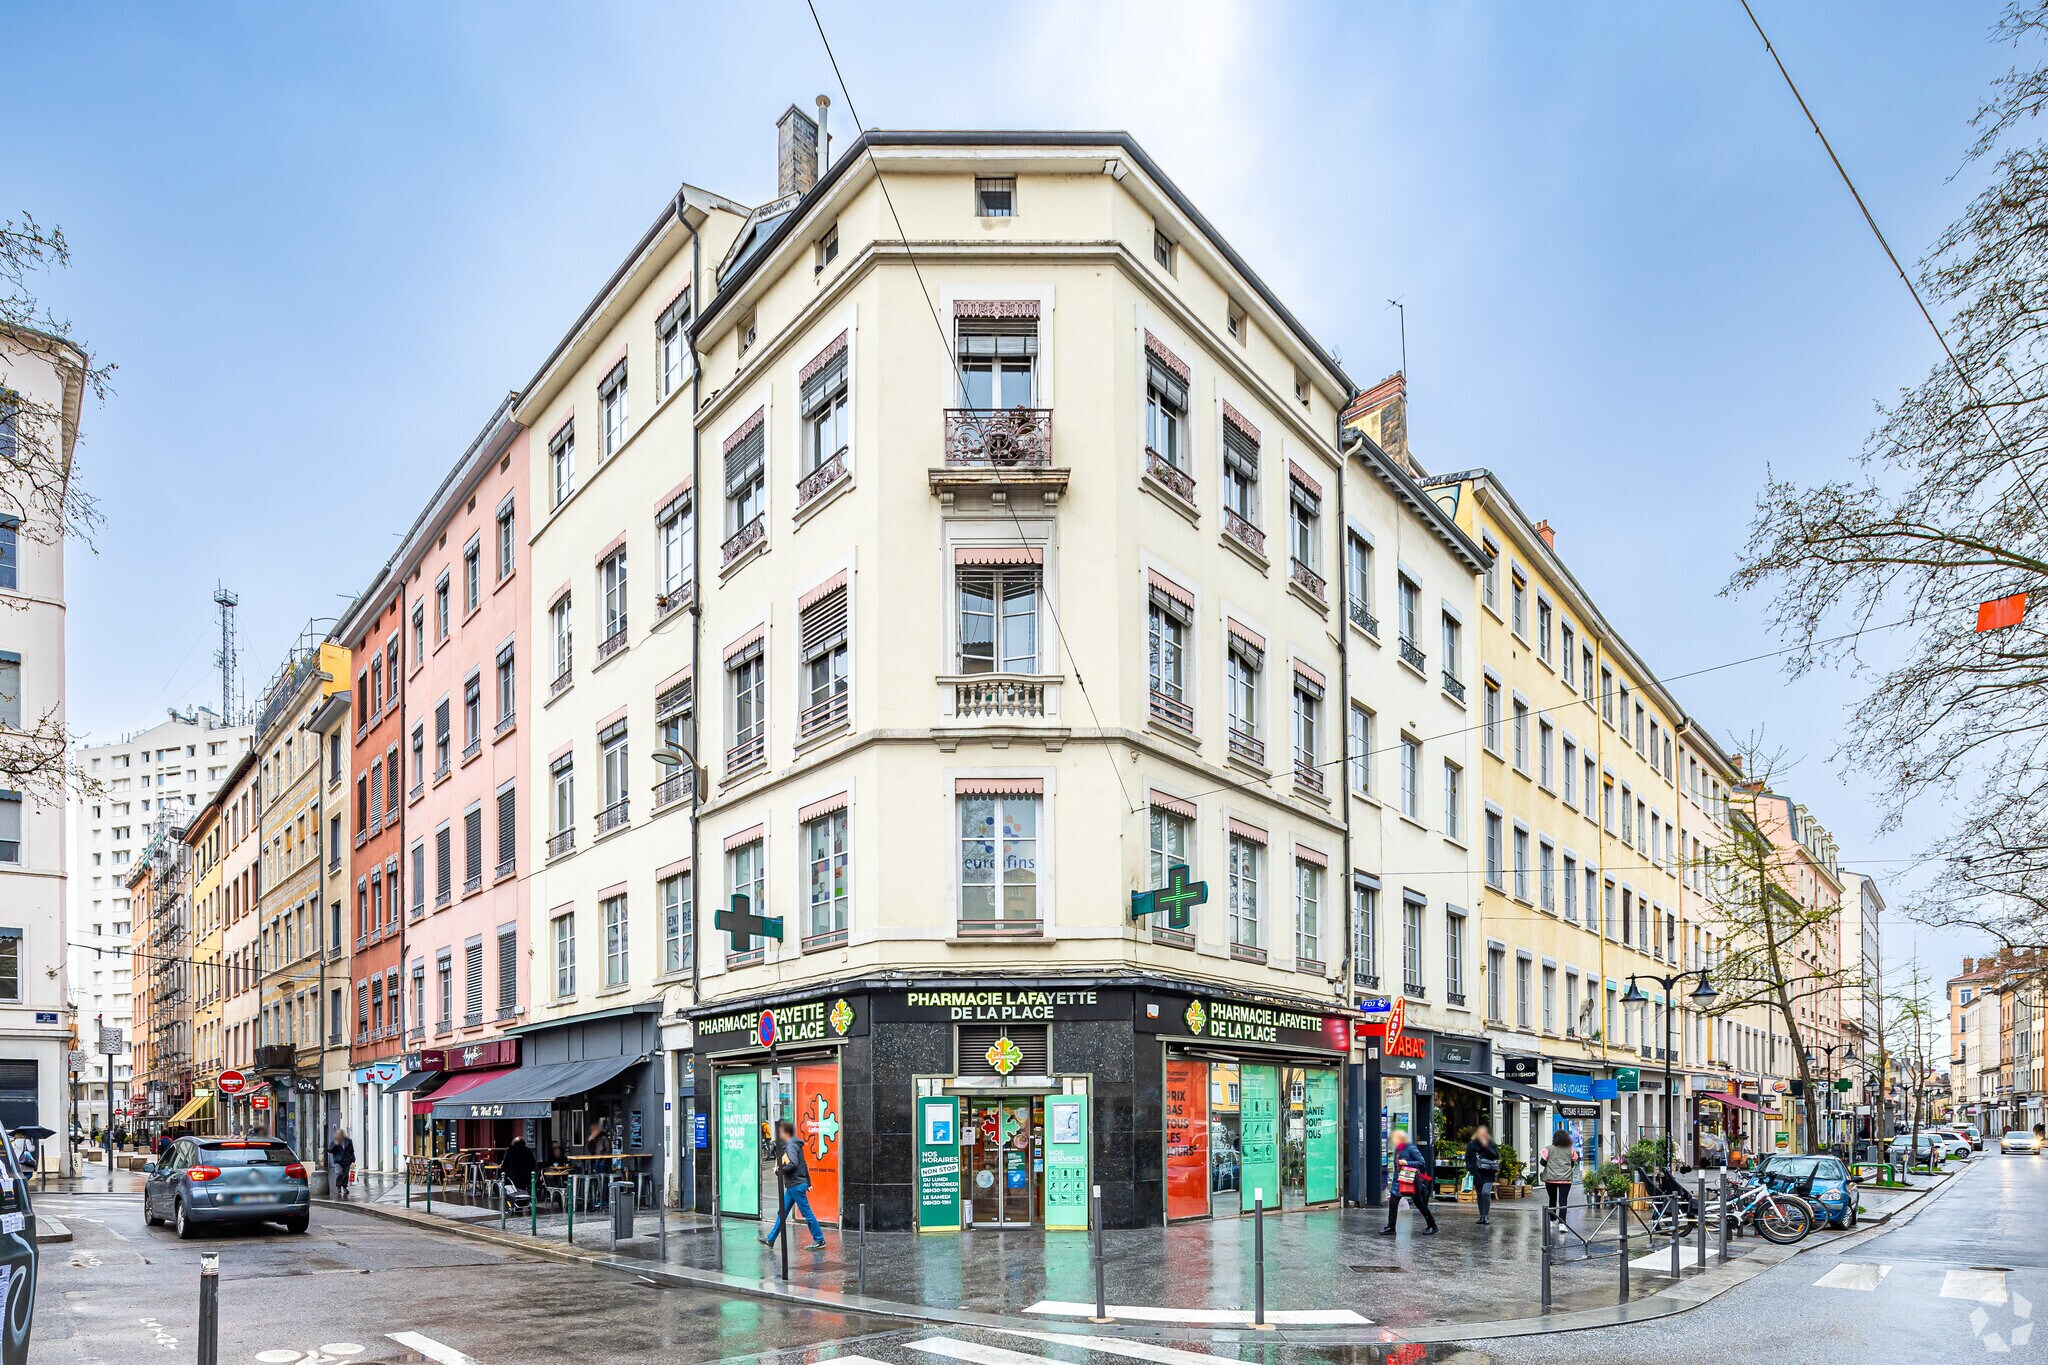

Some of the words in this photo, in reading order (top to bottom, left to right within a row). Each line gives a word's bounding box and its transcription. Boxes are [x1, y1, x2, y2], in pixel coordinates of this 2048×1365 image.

[907, 992, 1003, 1006] PHARMACIE
[1006, 992, 1097, 1006] LAFAYETTE
[950, 1006, 973, 1020] DE
[976, 1006, 998, 1020] LA
[1002, 1006, 1054, 1020] PLACE
[1210, 1002, 1272, 1026] PHARMACIE
[1273, 1012, 1322, 1032] LAFAYETTE
[699, 1012, 758, 1036] PHARMACIE
[760, 1002, 825, 1024] FAYETTE
[784, 1020, 825, 1040] PLACE
[1210, 1020, 1226, 1037] DE
[1228, 1023, 1243, 1039] LA
[1244, 1025, 1277, 1042] PLACE
[1388, 1007, 1401, 1044] TABAC
[1567, 1084, 1589, 1094] VOYAGES
[1166, 1091, 1186, 1101] PRIX
[492, 1104, 504, 1116] Pub
[723, 1102, 733, 1112] LE
[1166, 1105, 1183, 1115] BAS
[1305, 1104, 1324, 1115] SANTÉ
[723, 1113, 757, 1125] NATUREL
[1166, 1119, 1189, 1129] TOUS
[1305, 1118, 1322, 1127] POUR
[723, 1126, 746, 1137] POUR
[1305, 1130, 1322, 1139] TOUS
[1166, 1133, 1181, 1143] LES
[723, 1139, 745, 1150] TOUS
[939, 1165, 957, 1173] STOP
